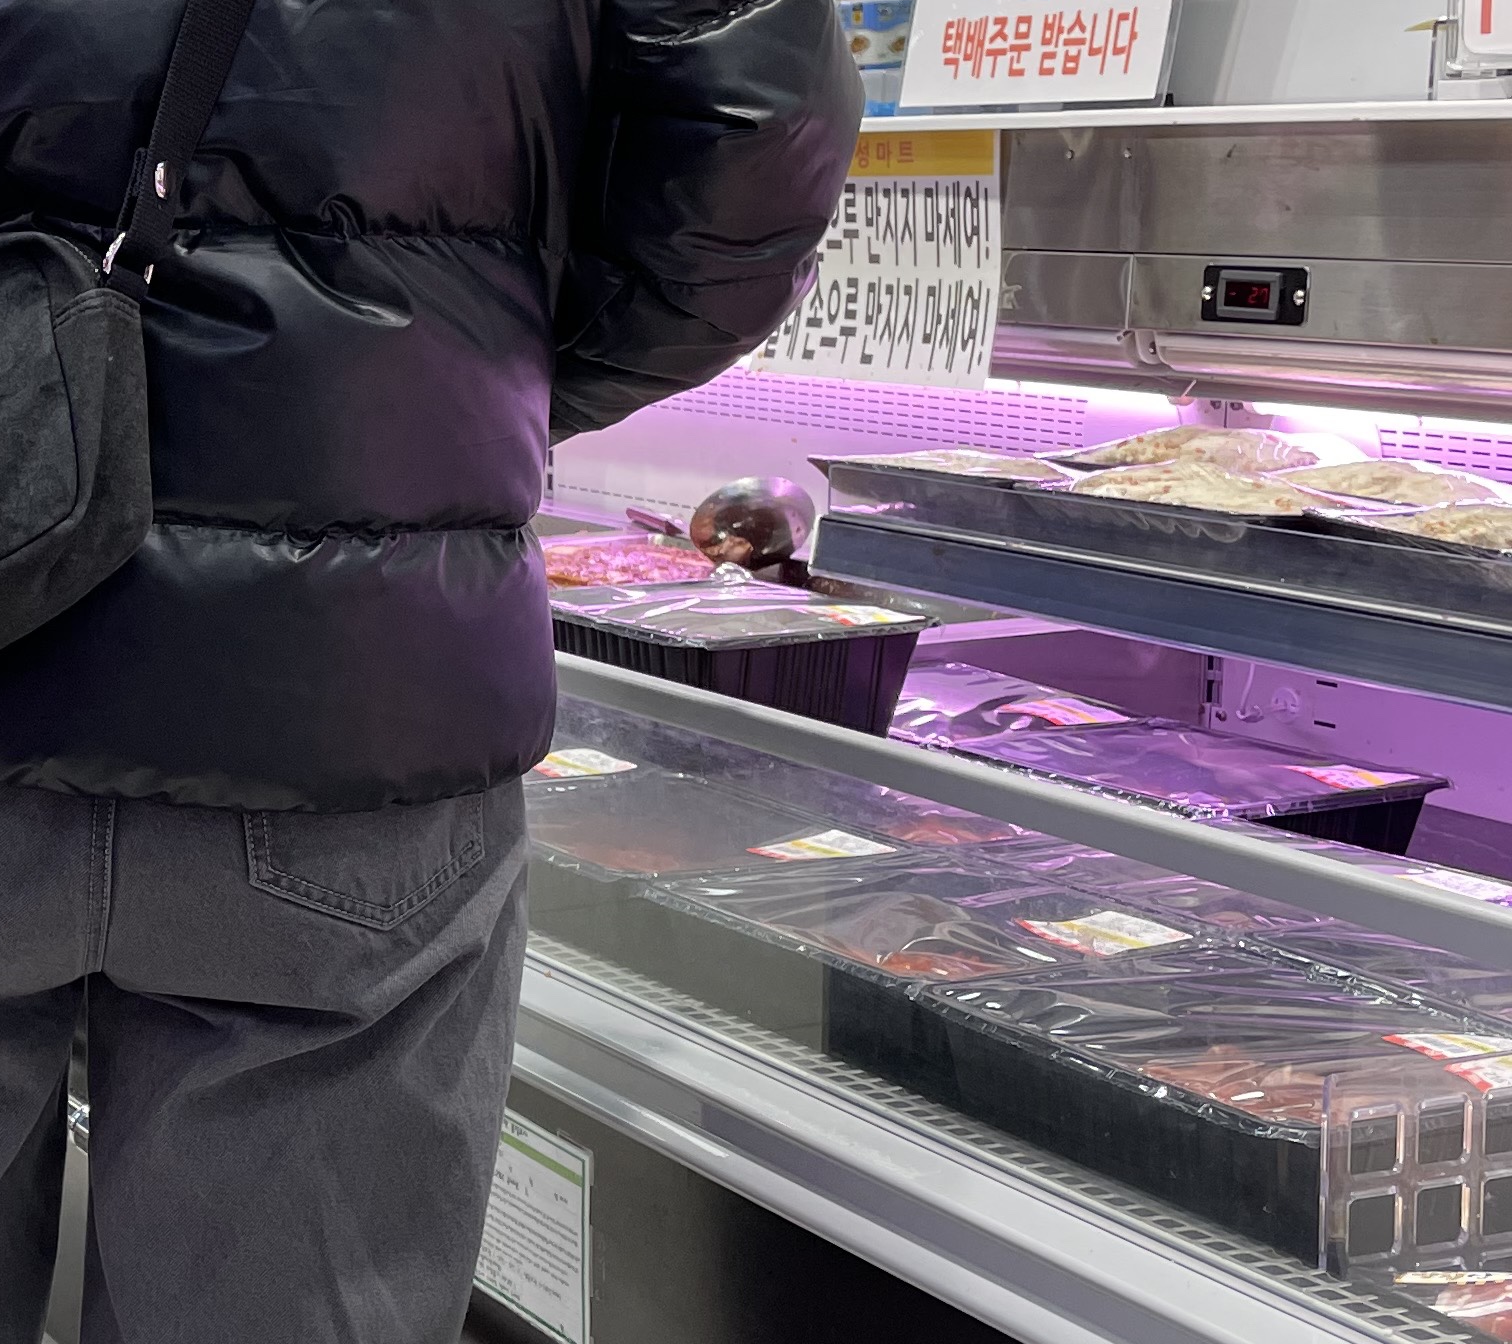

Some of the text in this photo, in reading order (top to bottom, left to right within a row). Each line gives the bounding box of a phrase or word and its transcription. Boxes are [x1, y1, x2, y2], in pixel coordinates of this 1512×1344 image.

[942, 7, 1138, 80] 택배주문 받습니다
[864, 181, 918, 267] 만지지
[859, 276, 919, 369] 만지지
